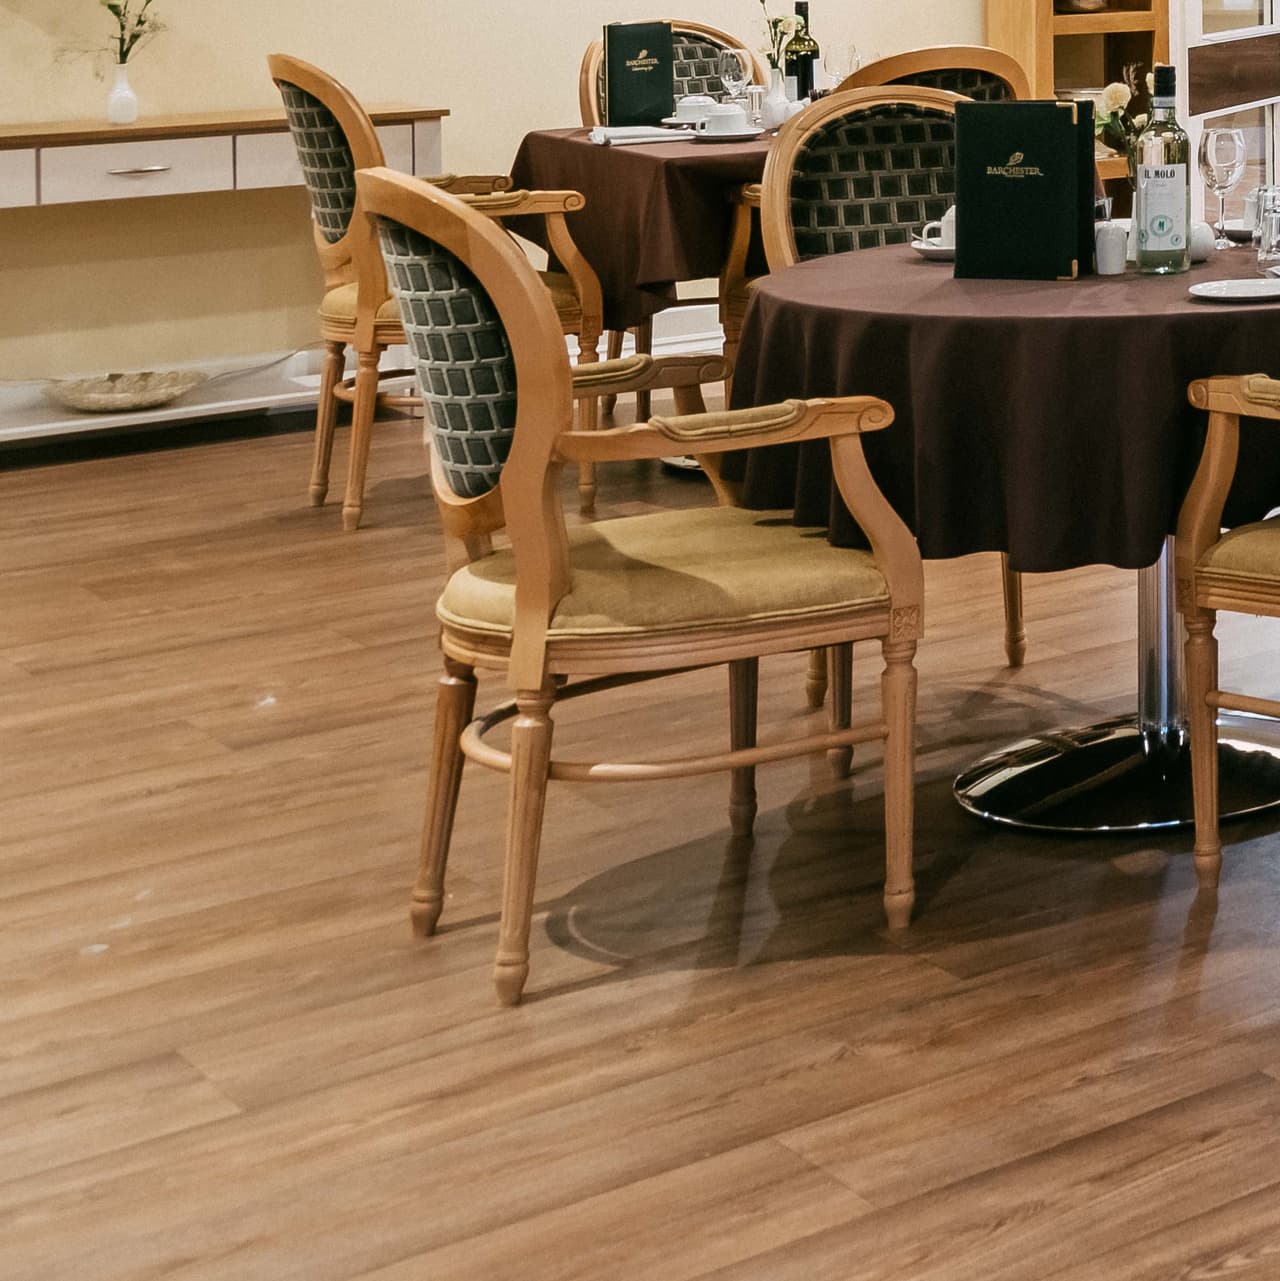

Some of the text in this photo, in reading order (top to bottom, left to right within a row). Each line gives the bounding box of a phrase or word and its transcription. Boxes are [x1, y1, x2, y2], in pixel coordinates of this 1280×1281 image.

[986, 166, 1044, 176] BARCHESTER
[1144, 168, 1175, 179] IL MOLO
